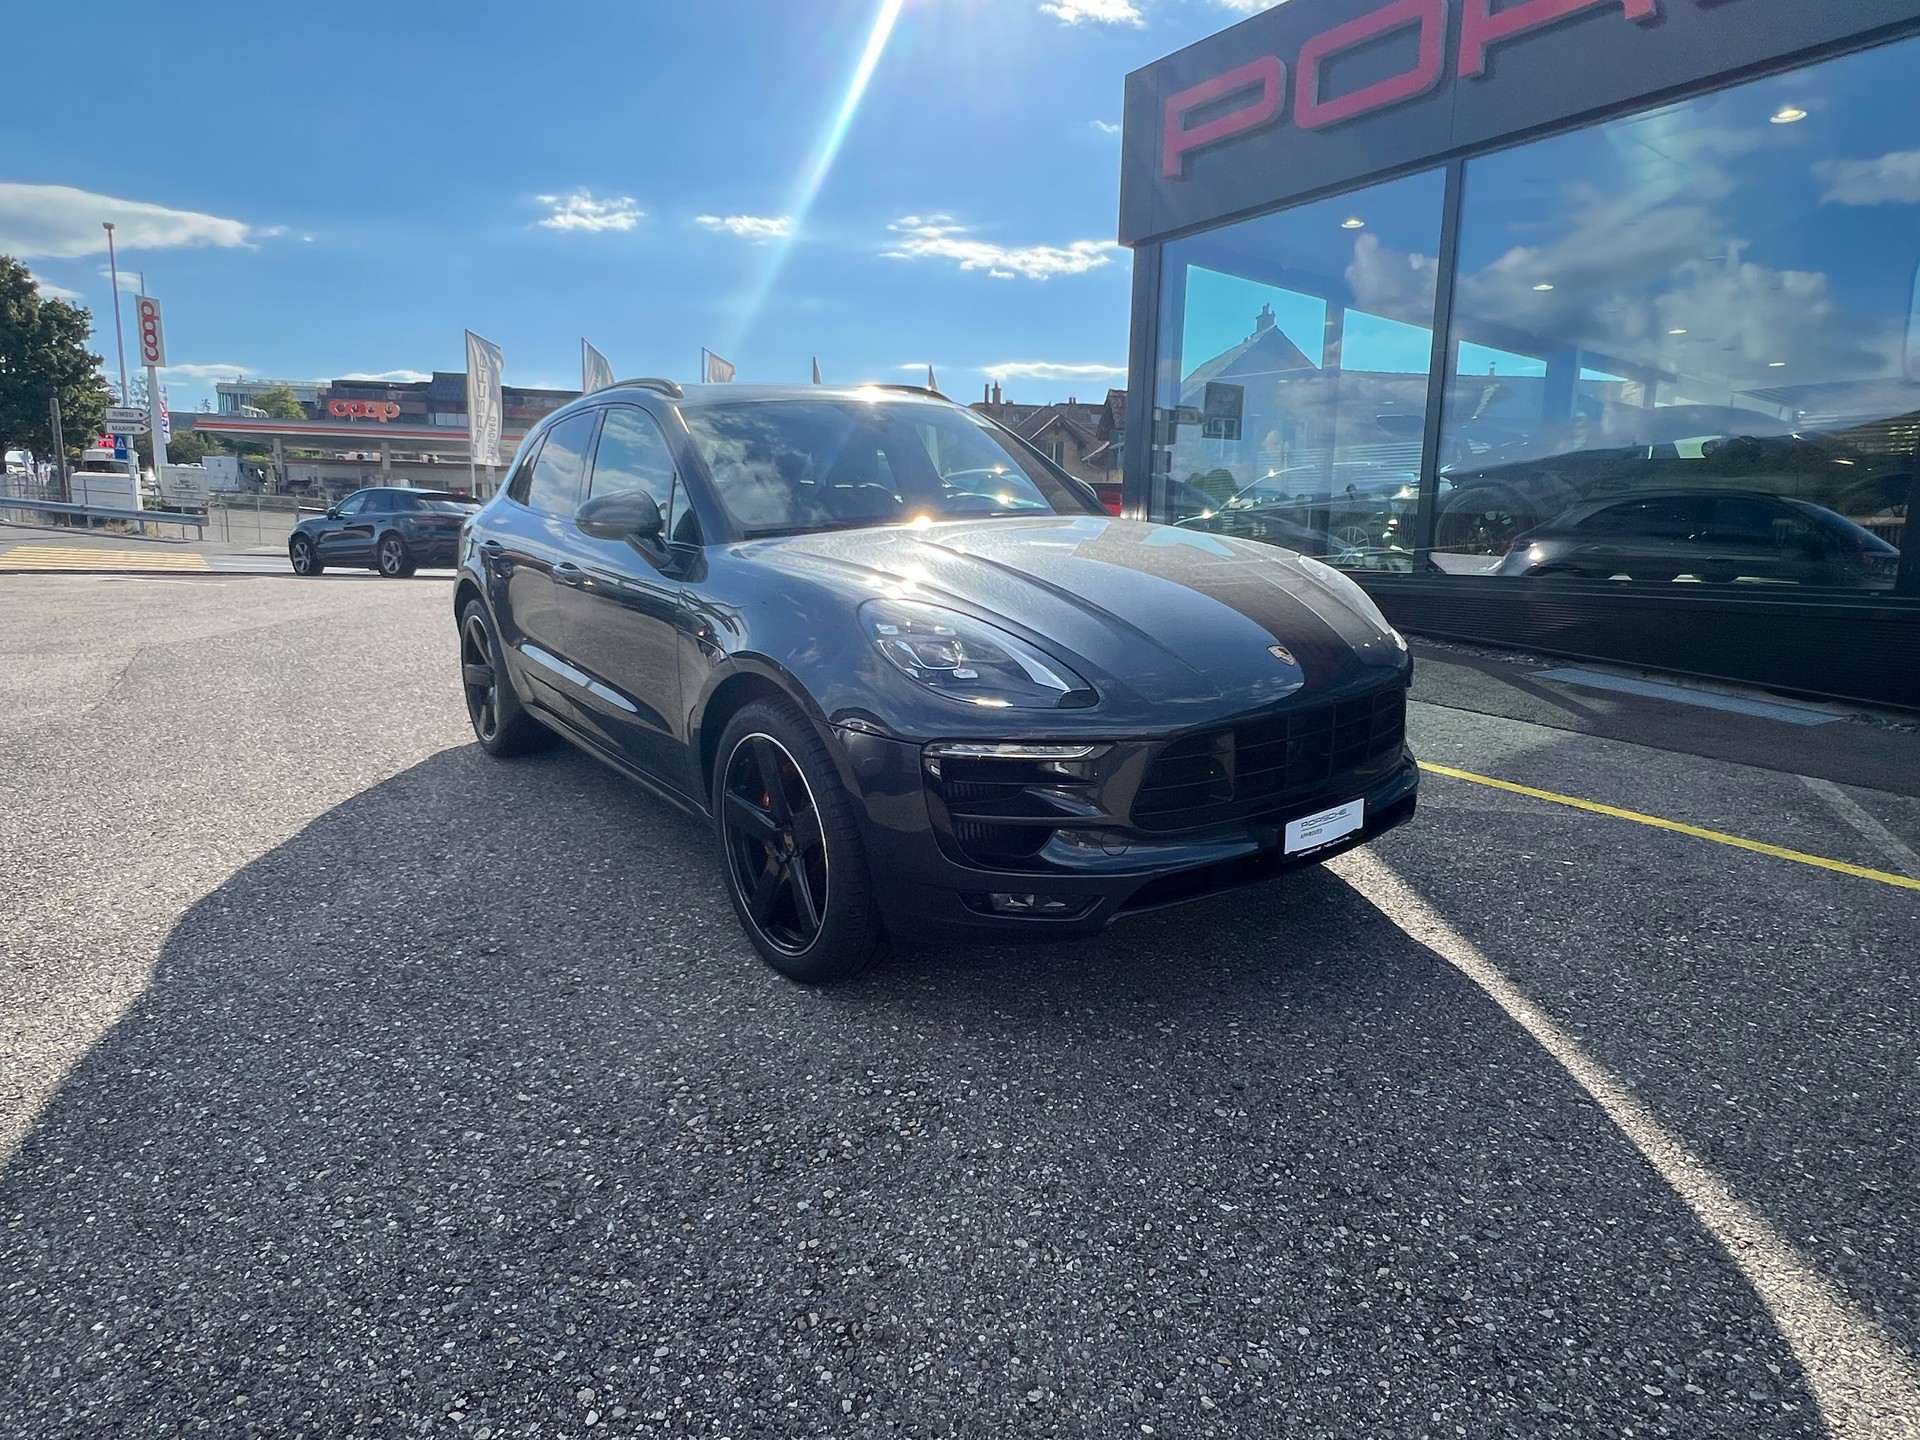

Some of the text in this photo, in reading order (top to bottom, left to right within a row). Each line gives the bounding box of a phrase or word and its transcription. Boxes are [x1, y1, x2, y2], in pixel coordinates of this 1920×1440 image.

[140, 301, 159, 362] coop
[328, 400, 400, 423] coop
[1300, 808, 1347, 828] PORSCHE
